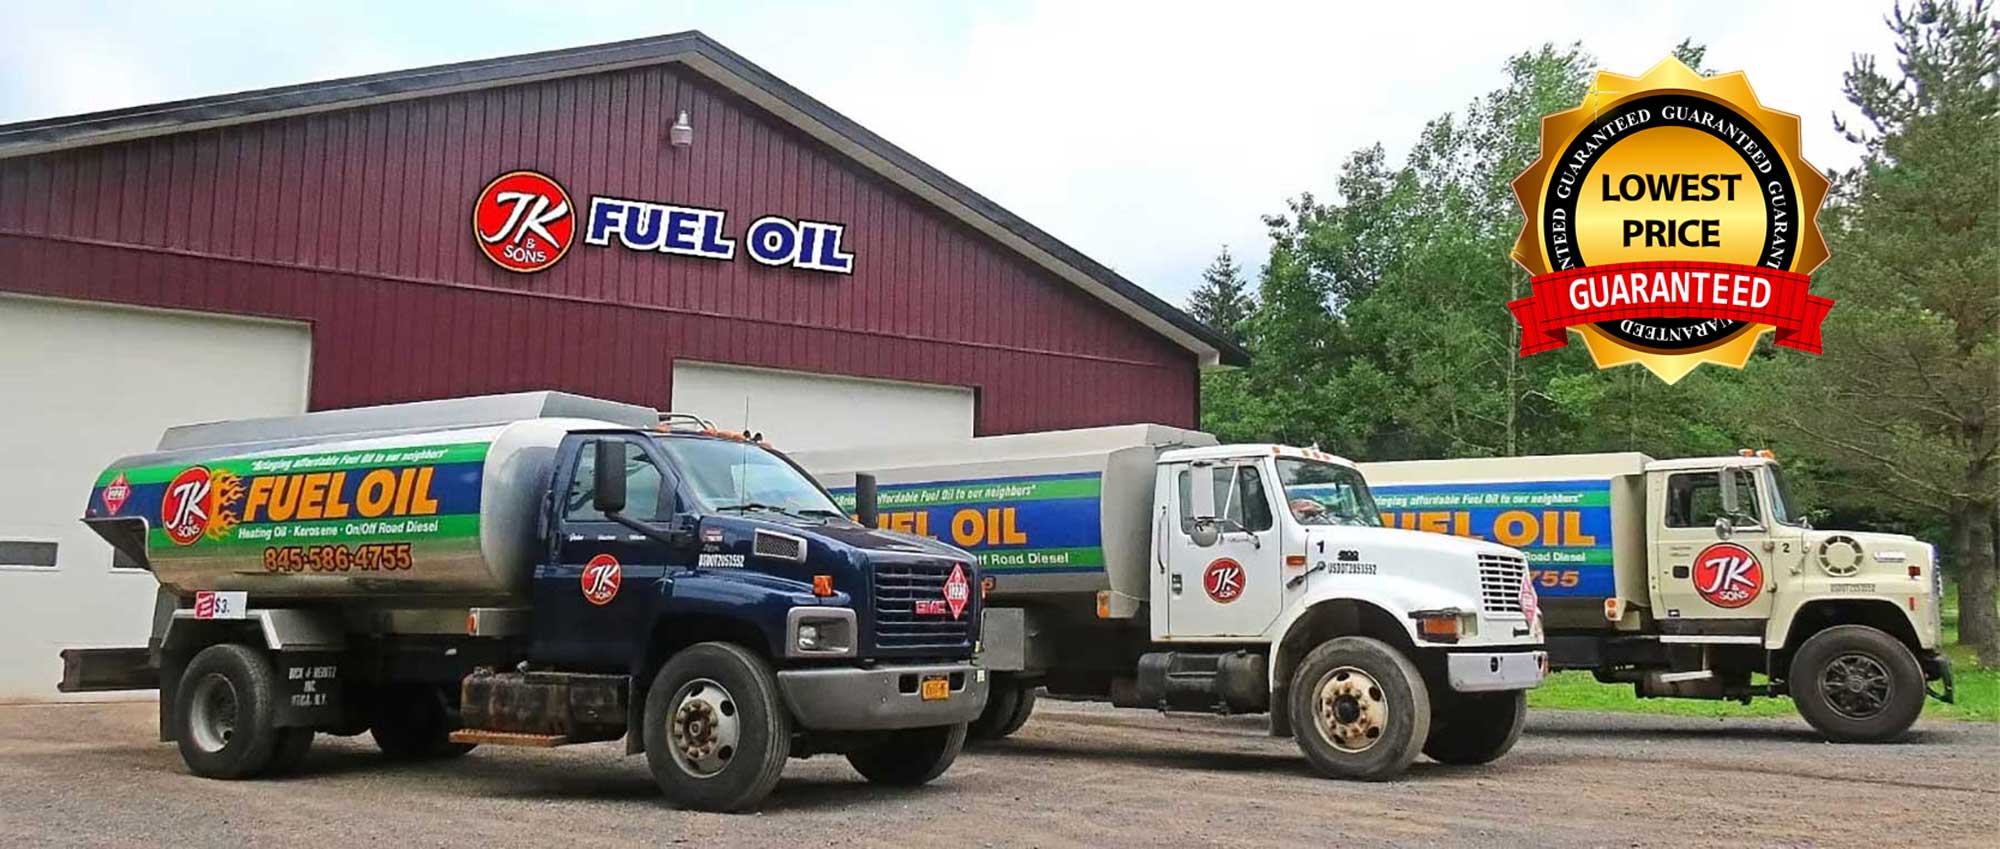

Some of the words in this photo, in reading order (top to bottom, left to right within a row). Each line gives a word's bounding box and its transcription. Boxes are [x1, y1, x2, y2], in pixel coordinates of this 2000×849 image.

[480, 191, 568, 249] JK
[525, 238, 535, 248] &
[586, 196, 735, 260] FUEL
[747, 216, 854, 273] OIL
[504, 244, 546, 263] SONS
[242, 470, 347, 522] FUEL
[355, 465, 439, 514] OIL
[920, 490, 940, 501] Fuel
[941, 488, 954, 500] Oil
[955, 488, 965, 499] to
[967, 489, 982, 499] our
[1409, 494, 1460, 506] affordable
[1461, 494, 1484, 504] Fuel
[1484, 493, 1499, 504] Oil
[1500, 493, 1511, 503] to
[1512, 494, 1530, 503] our
[166, 480, 211, 529] JK
[176, 523, 200, 538] SONS
[238, 526, 272, 541] Heating
[274, 525, 287, 538] Oil
[293, 523, 338, 538] Kerosene
[345, 521, 378, 536] On/Off
[378, 520, 404, 535] Road
[406, 520, 439, 533] Diesel
[951, 507, 1027, 546] OIL
[1493, 511, 1595, 547] OIL
[1316, 540, 1325, 554] 1
[1553, 551, 1586, 562] Diesel
[1782, 542, 1791, 554] 2
[991, 552, 1024, 565] Road
[1028, 552, 1069, 564] Diesel
[585, 565, 619, 595] JK
[1211, 567, 1240, 594] JK
[1700, 556, 1756, 594] JK
[1719, 590, 1749, 601] SONS
[915, 600, 946, 615] GMC
